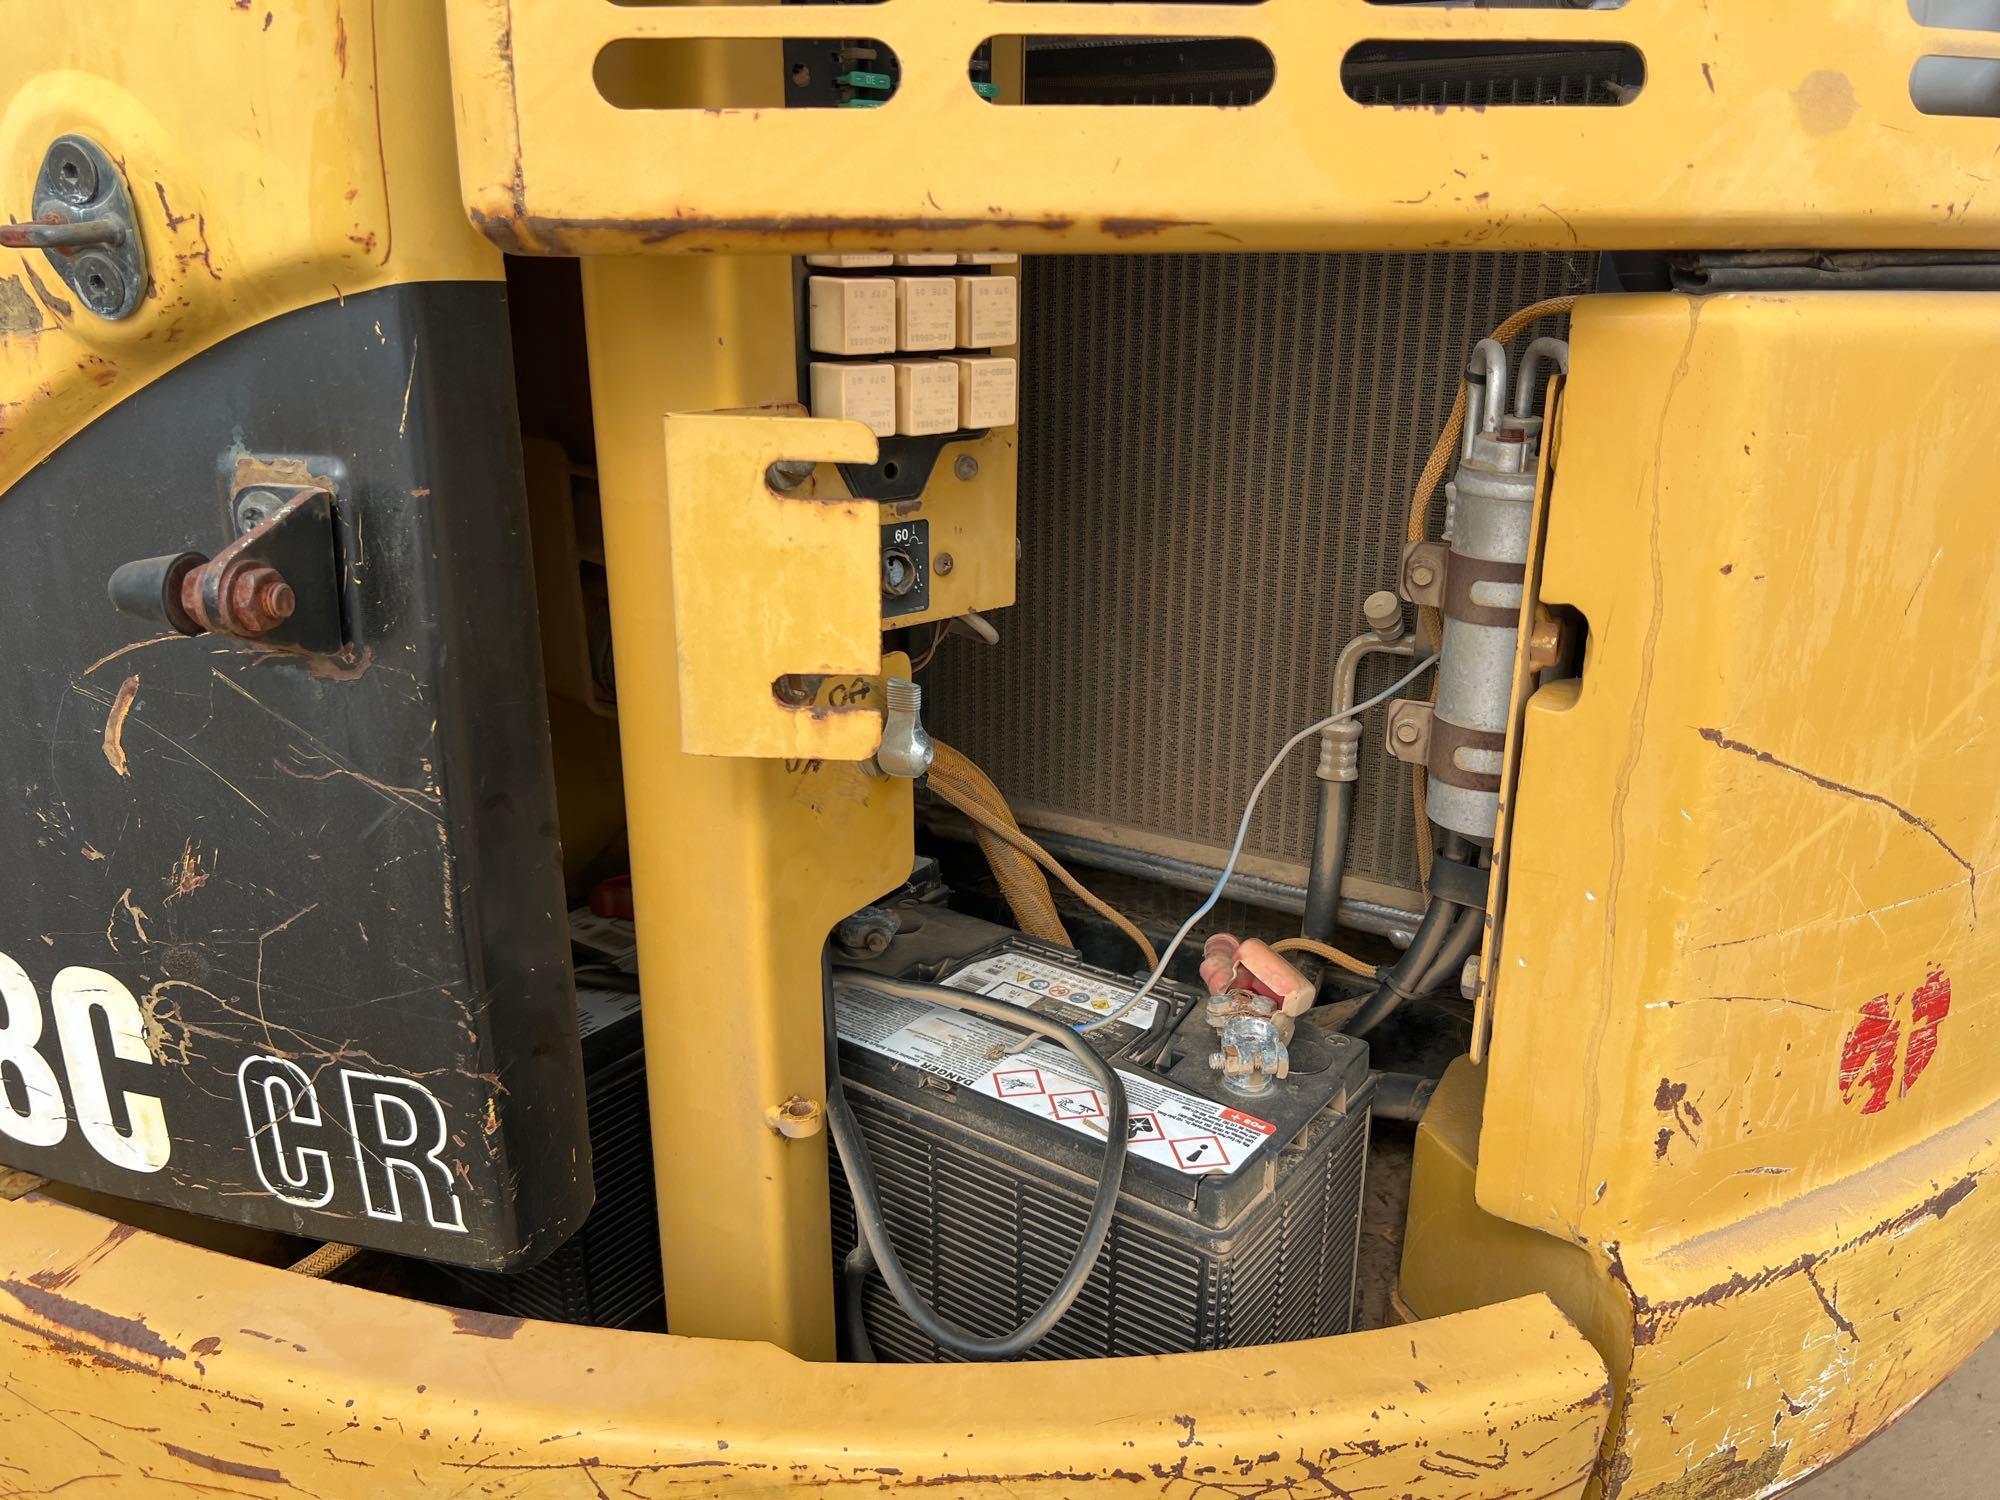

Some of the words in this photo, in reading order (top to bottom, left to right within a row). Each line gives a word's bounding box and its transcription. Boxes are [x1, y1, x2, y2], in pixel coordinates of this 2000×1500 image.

[895, 528, 909, 542] 60
[918, 1061, 975, 1086] DANGER
[1243, 1117, 1267, 1130] POS
[238, 1055, 470, 1233] CR
